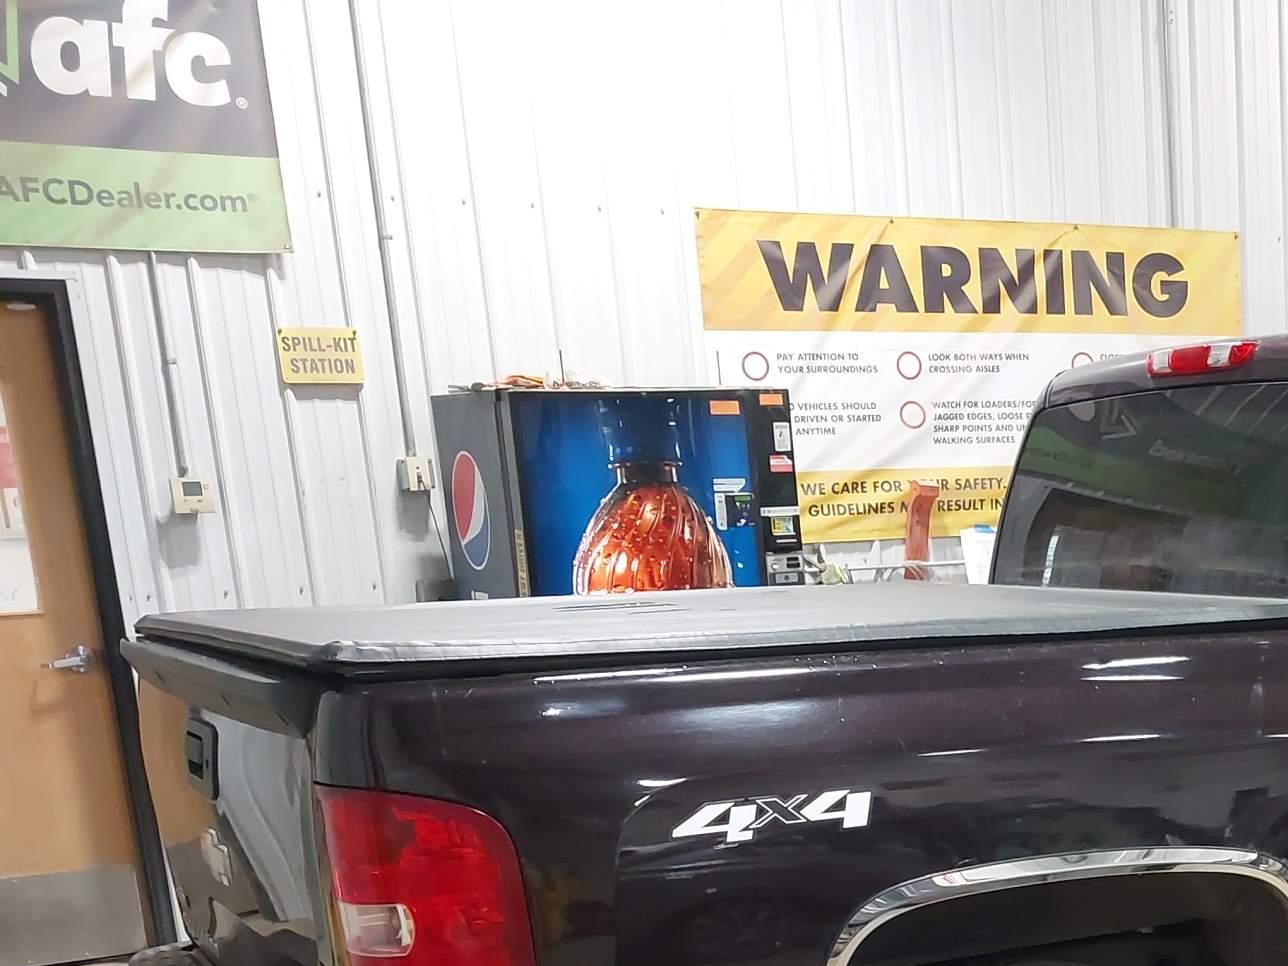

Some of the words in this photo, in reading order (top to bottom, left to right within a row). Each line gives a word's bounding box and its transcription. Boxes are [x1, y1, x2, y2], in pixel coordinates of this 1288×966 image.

[756, 239, 1189, 318] WARNING
[281, 336, 357, 352] SPILL-KIT
[776, 353, 794, 361] PAY
[797, 353, 845, 361] ATTENTION
[848, 353, 859, 361] TO
[928, 353, 951, 361] LOOK
[953, 353, 977, 361] BOTH
[978, 353, 1003, 361] WAYS
[1005, 353, 1030, 361] WHEN
[290, 358, 356, 374] STATION
[778, 365, 804, 374] YOUR
[806, 365, 878, 374] SURROUNDINGS
[928, 365, 973, 374] CROSSING
[975, 365, 1001, 373] AISLES
[797, 402, 839, 411] VEHICLES
[841, 402, 877, 410] SHOULD
[932, 401, 962, 409] WATCH
[963, 401, 979, 409] FOR
[794, 415, 828, 423] DRIVEN
[830, 415, 844, 423] OR
[846, 414, 882, 422] STARTED
[933, 413, 964, 421] JAGGED
[997, 412, 1025, 420] LOOSE
[796, 427, 836, 435] ANYTIME
[933, 425, 960, 433] SHARP
[962, 424, 992, 432] POINTS
[995, 424, 1014, 432] AND
[933, 436, 974, 444] WALKING
[975, 436, 1016, 444] SURFACES
[800, 482, 826, 496] WE
[831, 481, 868, 495] CARE
[873, 480, 903, 493] FOR
[955, 477, 1006, 491] SAFETY.
[808, 501, 895, 517] GUIDELINES
[938, 498, 984, 512] RESULT
